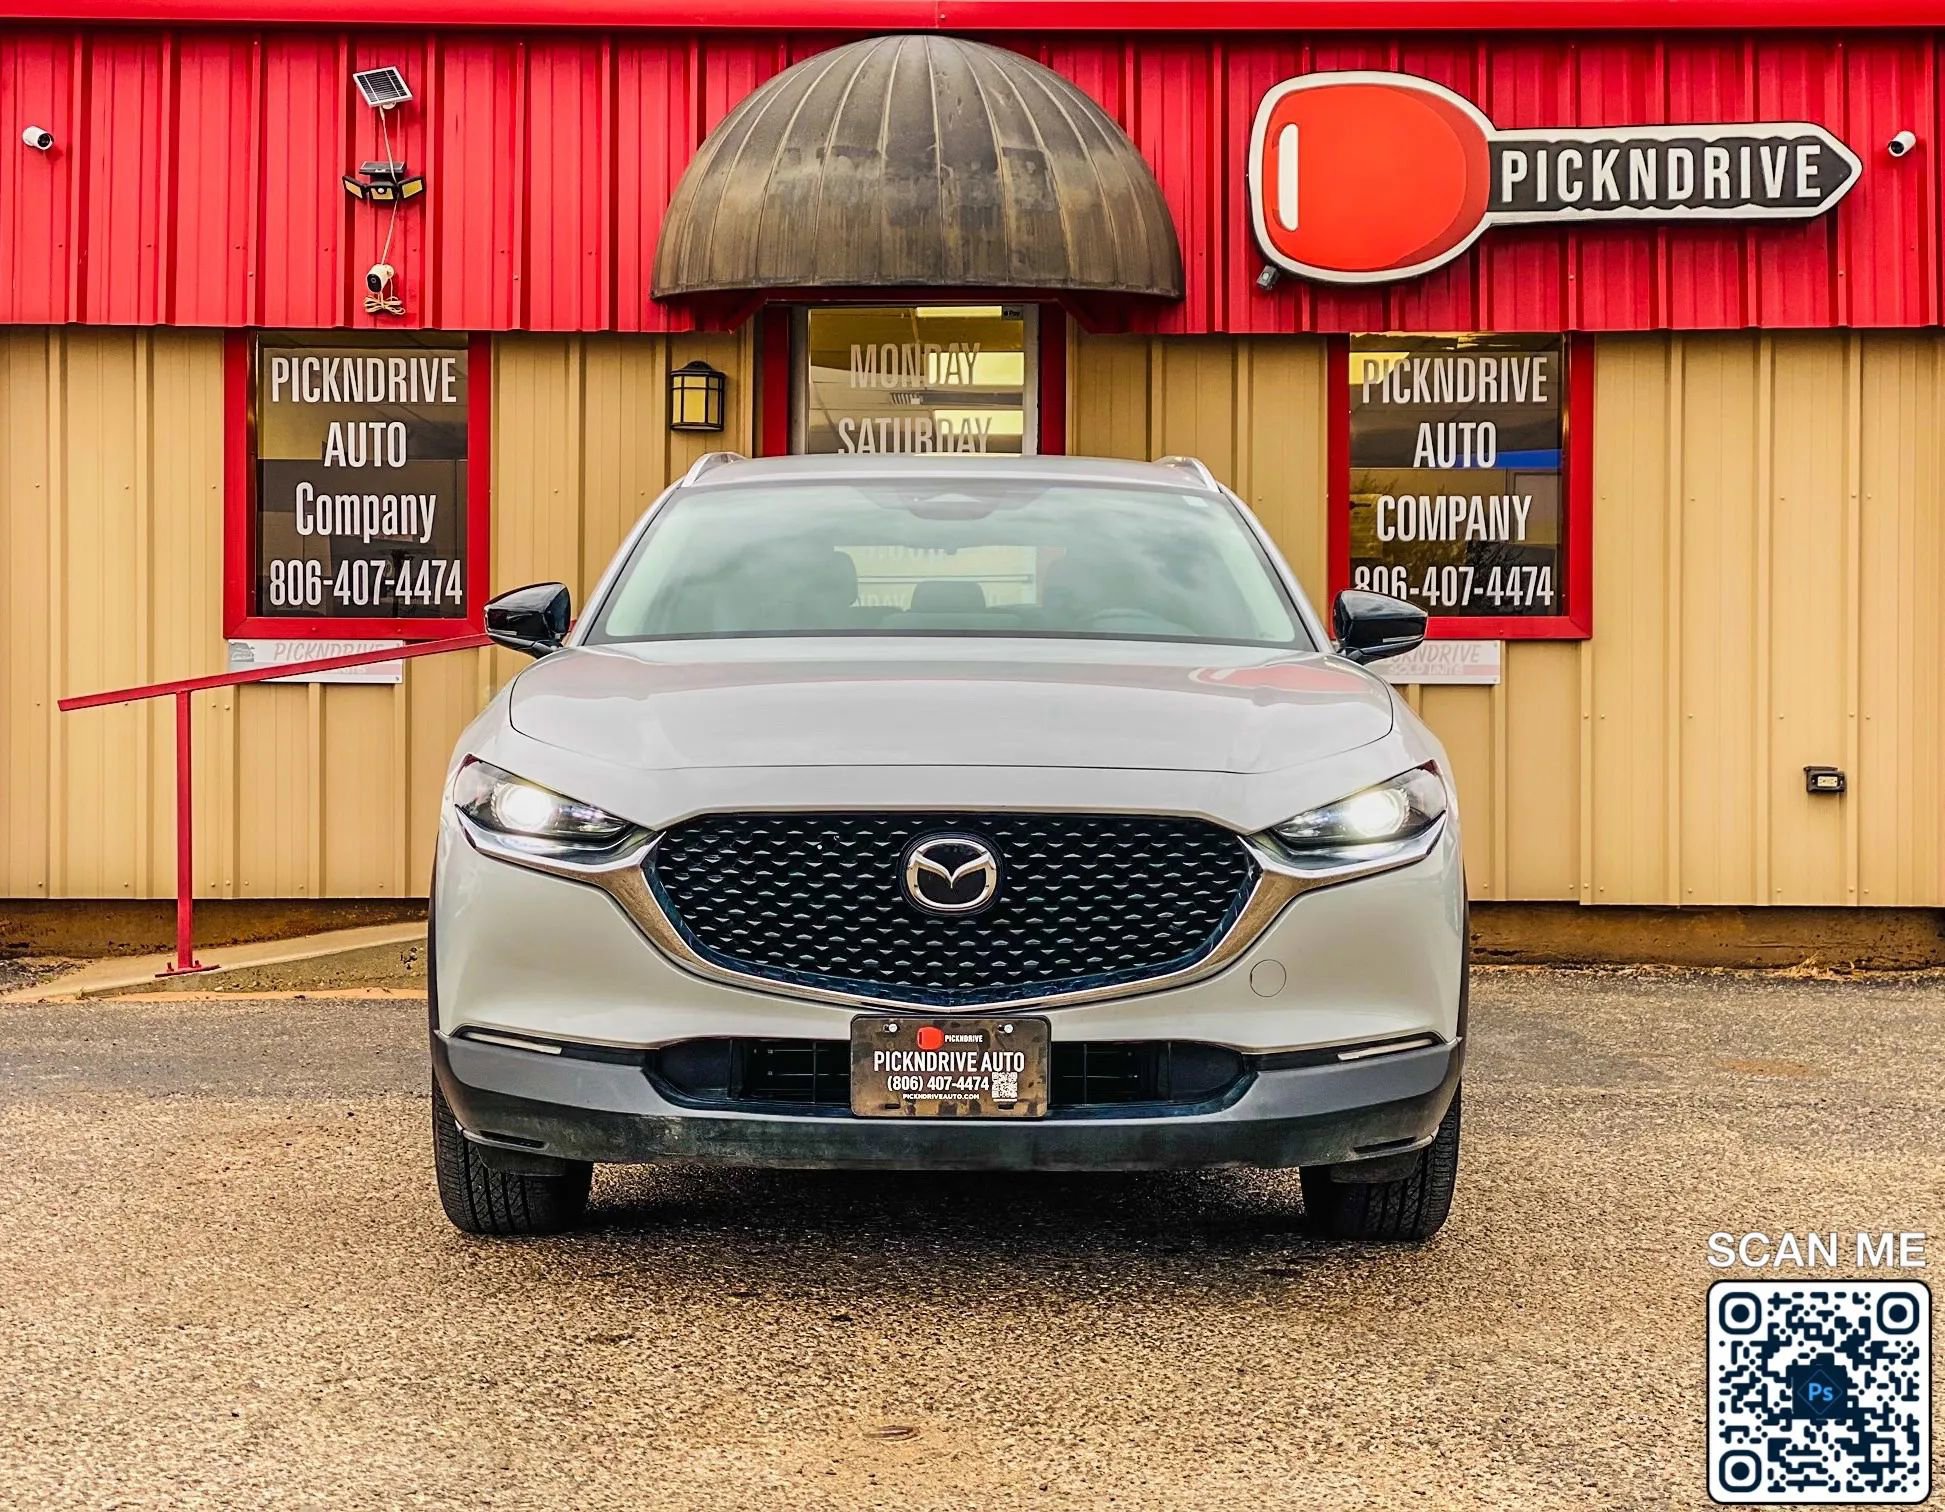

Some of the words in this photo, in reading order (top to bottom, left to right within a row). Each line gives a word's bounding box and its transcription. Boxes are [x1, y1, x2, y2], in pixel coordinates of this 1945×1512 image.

[1501, 144, 1821, 202] PICKNDRIVE
[271, 356, 457, 403] PICKNDRIVE
[850, 342, 980, 389] MONDAY
[1362, 357, 1548, 404] PICKNDRIVE
[323, 421, 407, 468] AUTO
[837, 416, 993, 455] SATURDAY
[1412, 421, 1497, 469] AUTO
[295, 481, 437, 544] Company
[1376, 494, 1533, 542] COMPANY
[269, 559, 463, 606] 806-407-4474
[1354, 565, 1554, 607] 806-407-4474
[273, 642, 386, 662] PICKNDR
[873, 1050, 977, 1072] PICKNDRIVE
[981, 1051, 1025, 1073] AUTO
[944, 1034, 984, 1043] PICKNDRIVE
[887, 1075, 924, 1092] (806)
[927, 1075, 989, 1091] 407-4474
